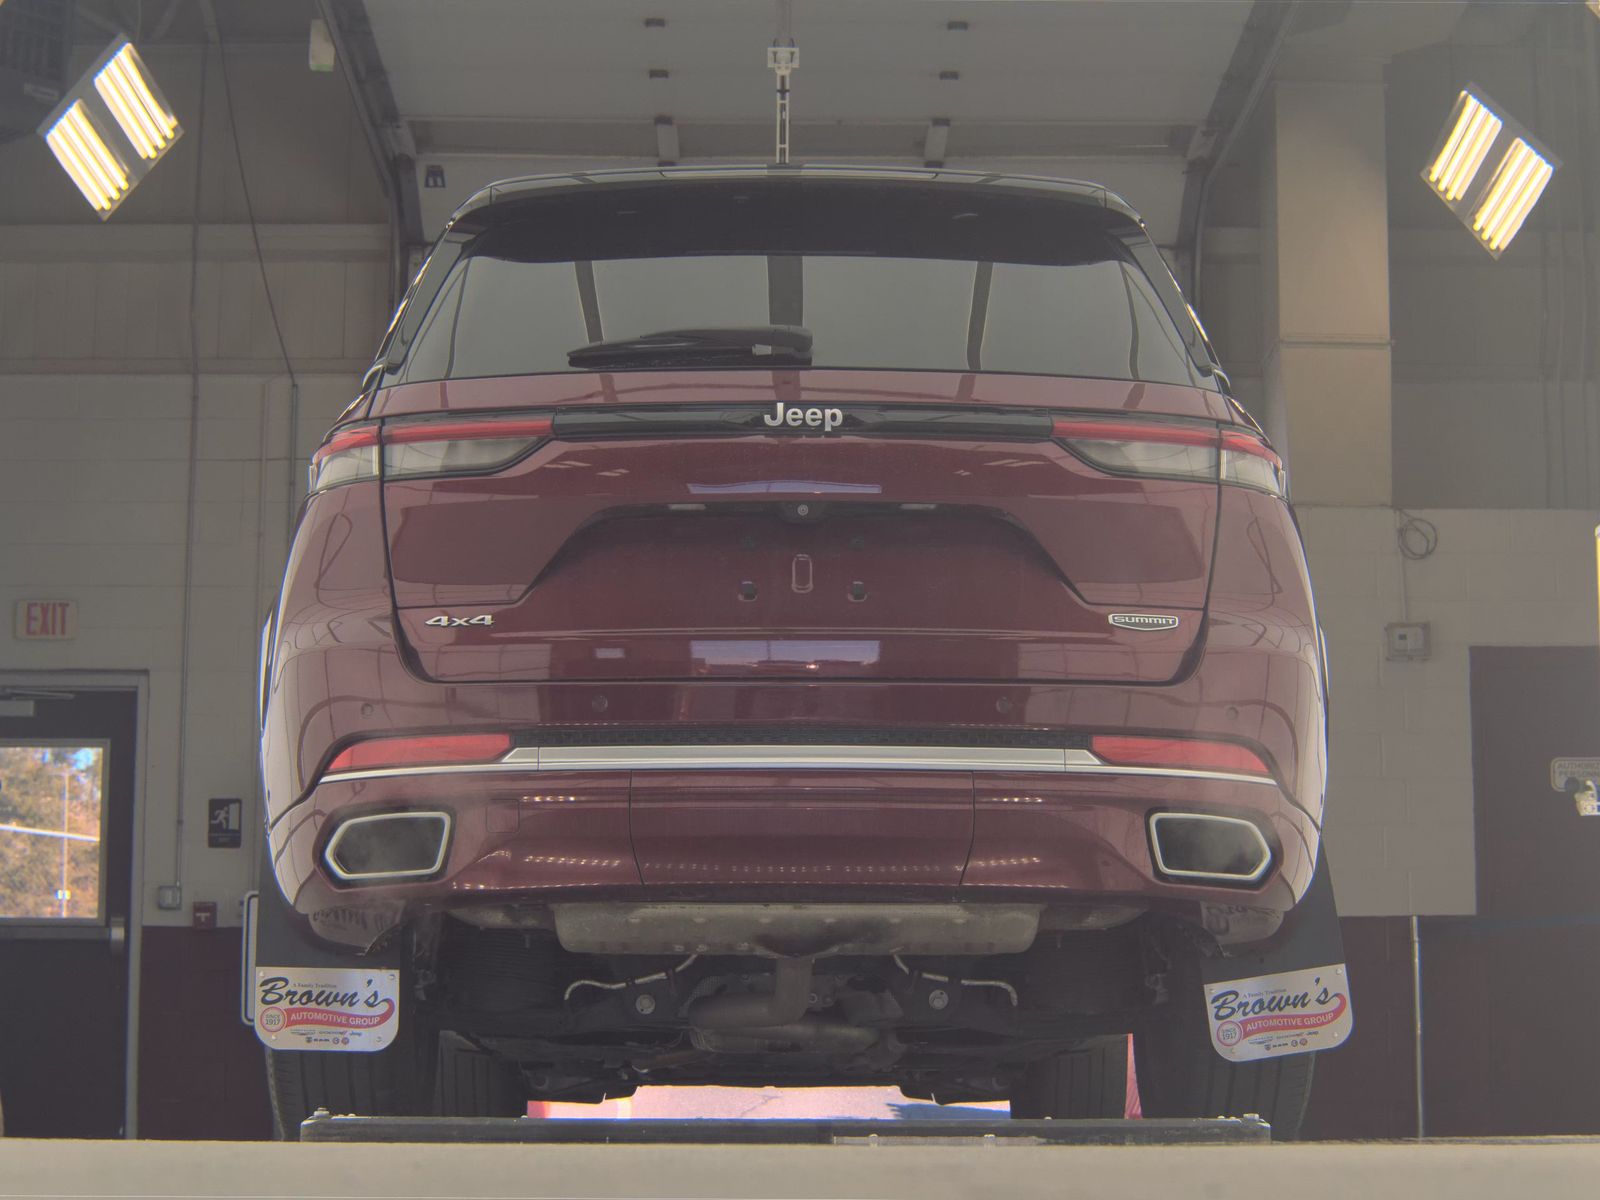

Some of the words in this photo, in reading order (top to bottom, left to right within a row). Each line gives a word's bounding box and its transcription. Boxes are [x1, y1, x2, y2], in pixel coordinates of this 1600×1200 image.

[764, 402, 843, 432] Jeep
[26, 602, 70, 636] EXIT
[425, 614, 496, 627] 4x4
[1114, 616, 1175, 624] SUMMIT
[259, 976, 384, 1008] Brown's
[1210, 976, 1338, 1020] Brown's
[290, 1011, 347, 1024] AUTOMOTIVE
[349, 1016, 380, 1026] GROUP
[1246, 1017, 1303, 1032] AUTOMOTIVE
[1303, 1012, 1335, 1026] GROUP
